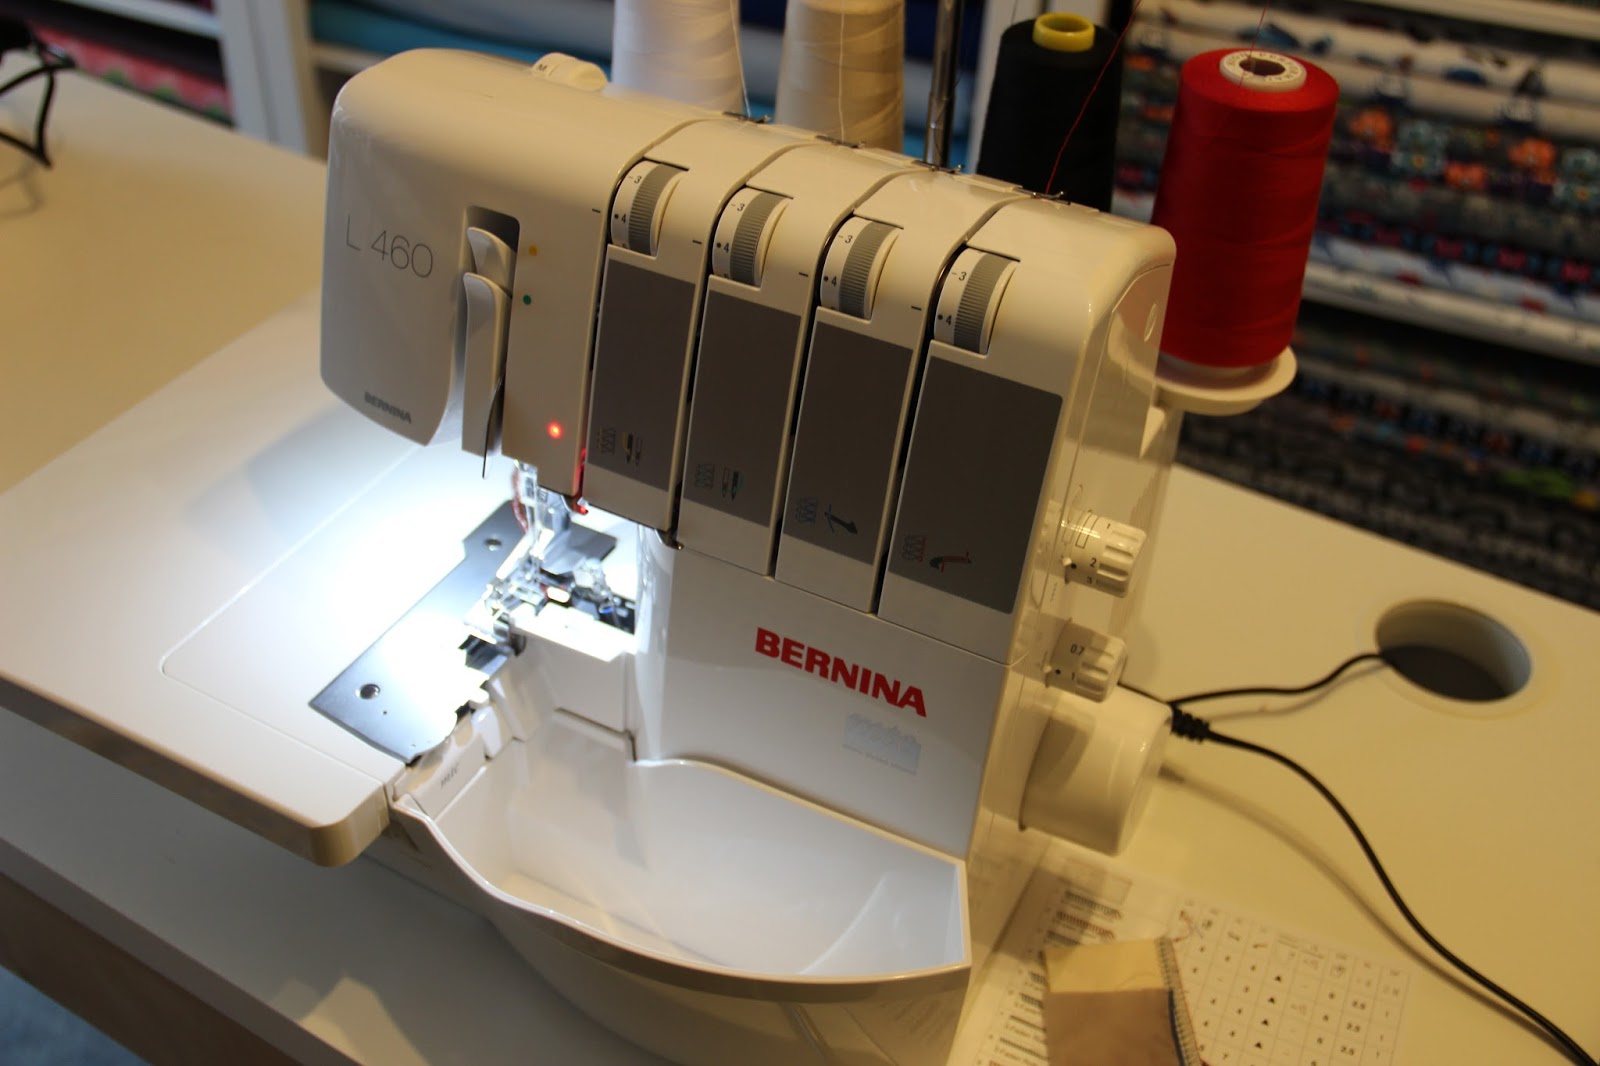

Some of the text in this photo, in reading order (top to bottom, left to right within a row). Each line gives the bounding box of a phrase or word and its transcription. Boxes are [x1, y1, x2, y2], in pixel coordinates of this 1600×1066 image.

[634, 175, 642, 184] 3
[737, 203, 745, 212] 3
[621, 213, 627, 224] 4
[844, 234, 853, 244] 3
[345, 214, 433, 278] L 460
[723, 243, 730, 253] 4
[831, 276, 837, 287] 4
[958, 271, 967, 282] 3
[945, 315, 952, 326] 4
[1090, 557, 1097, 568] 2
[1070, 643, 1085, 656] 0.7
[755, 627, 926, 717] BERNINA
